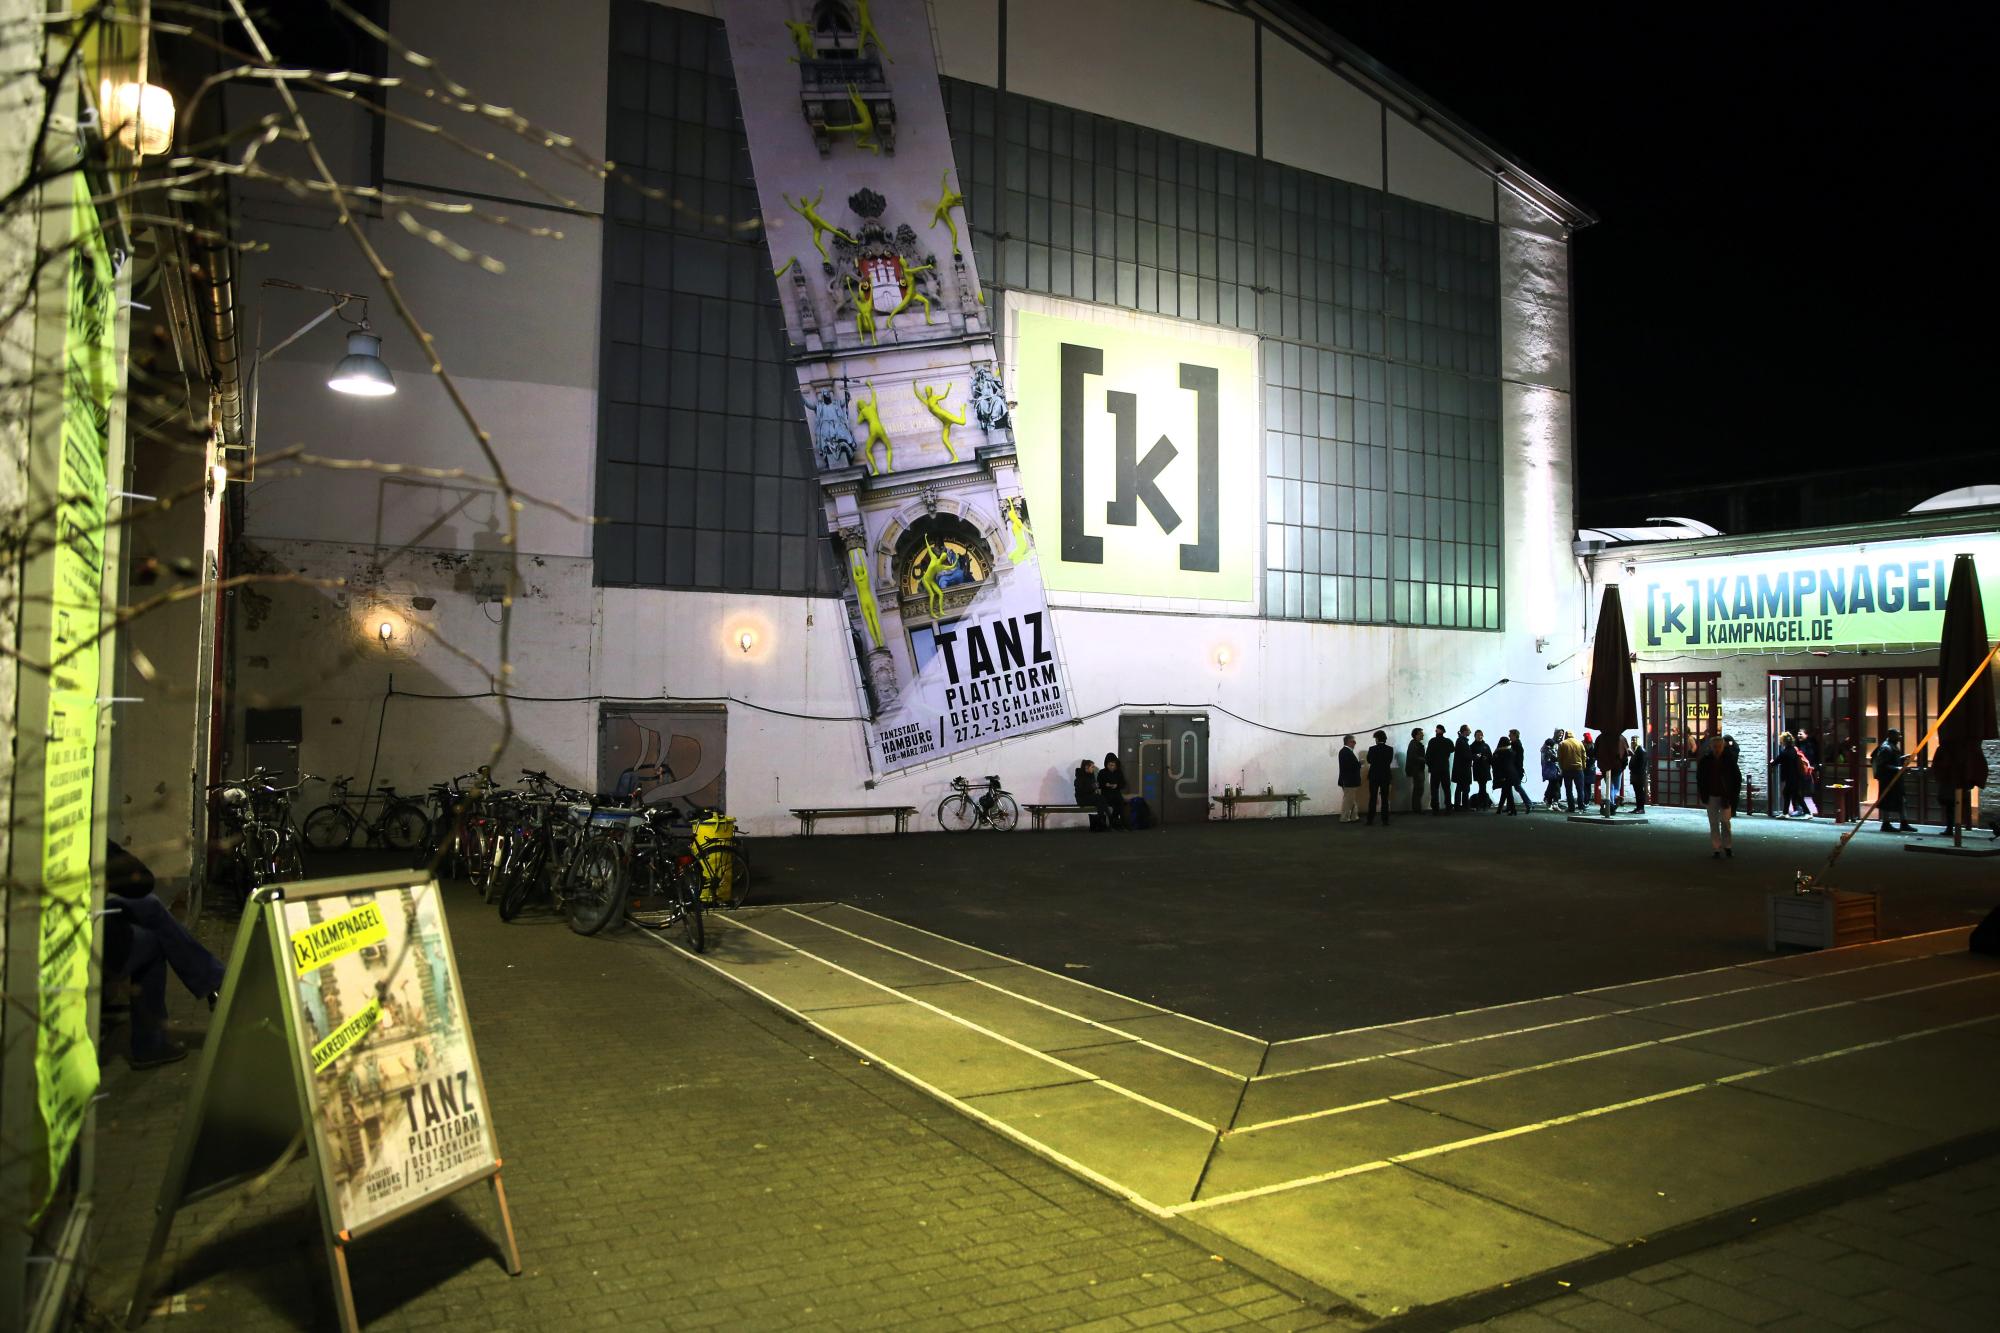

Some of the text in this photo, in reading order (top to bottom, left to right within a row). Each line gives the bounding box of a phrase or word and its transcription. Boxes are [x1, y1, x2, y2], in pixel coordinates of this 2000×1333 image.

[1707, 559, 1947, 621] KAMPNAGEL
[934, 611, 1052, 685] TANZ
[1707, 619, 1833, 644] KAMPNAGEL.DE
[945, 663, 1057, 710] PLATTFORM
[950, 685, 1060, 727] DEUTSCHLAND
[880, 722, 920, 741] TANZSTADT
[881, 730, 932, 754] HAMBURG
[920, 743, 934, 754] 2014
[312, 908, 379, 949] KAMPNAGEL
[312, 1006, 377, 1069] AKKREDITIERUNG
[400, 1070, 475, 1133] TANZ
[408, 1112, 480, 1154] PLATTFORM
[412, 1130, 481, 1169] DEUTSCHLAND
